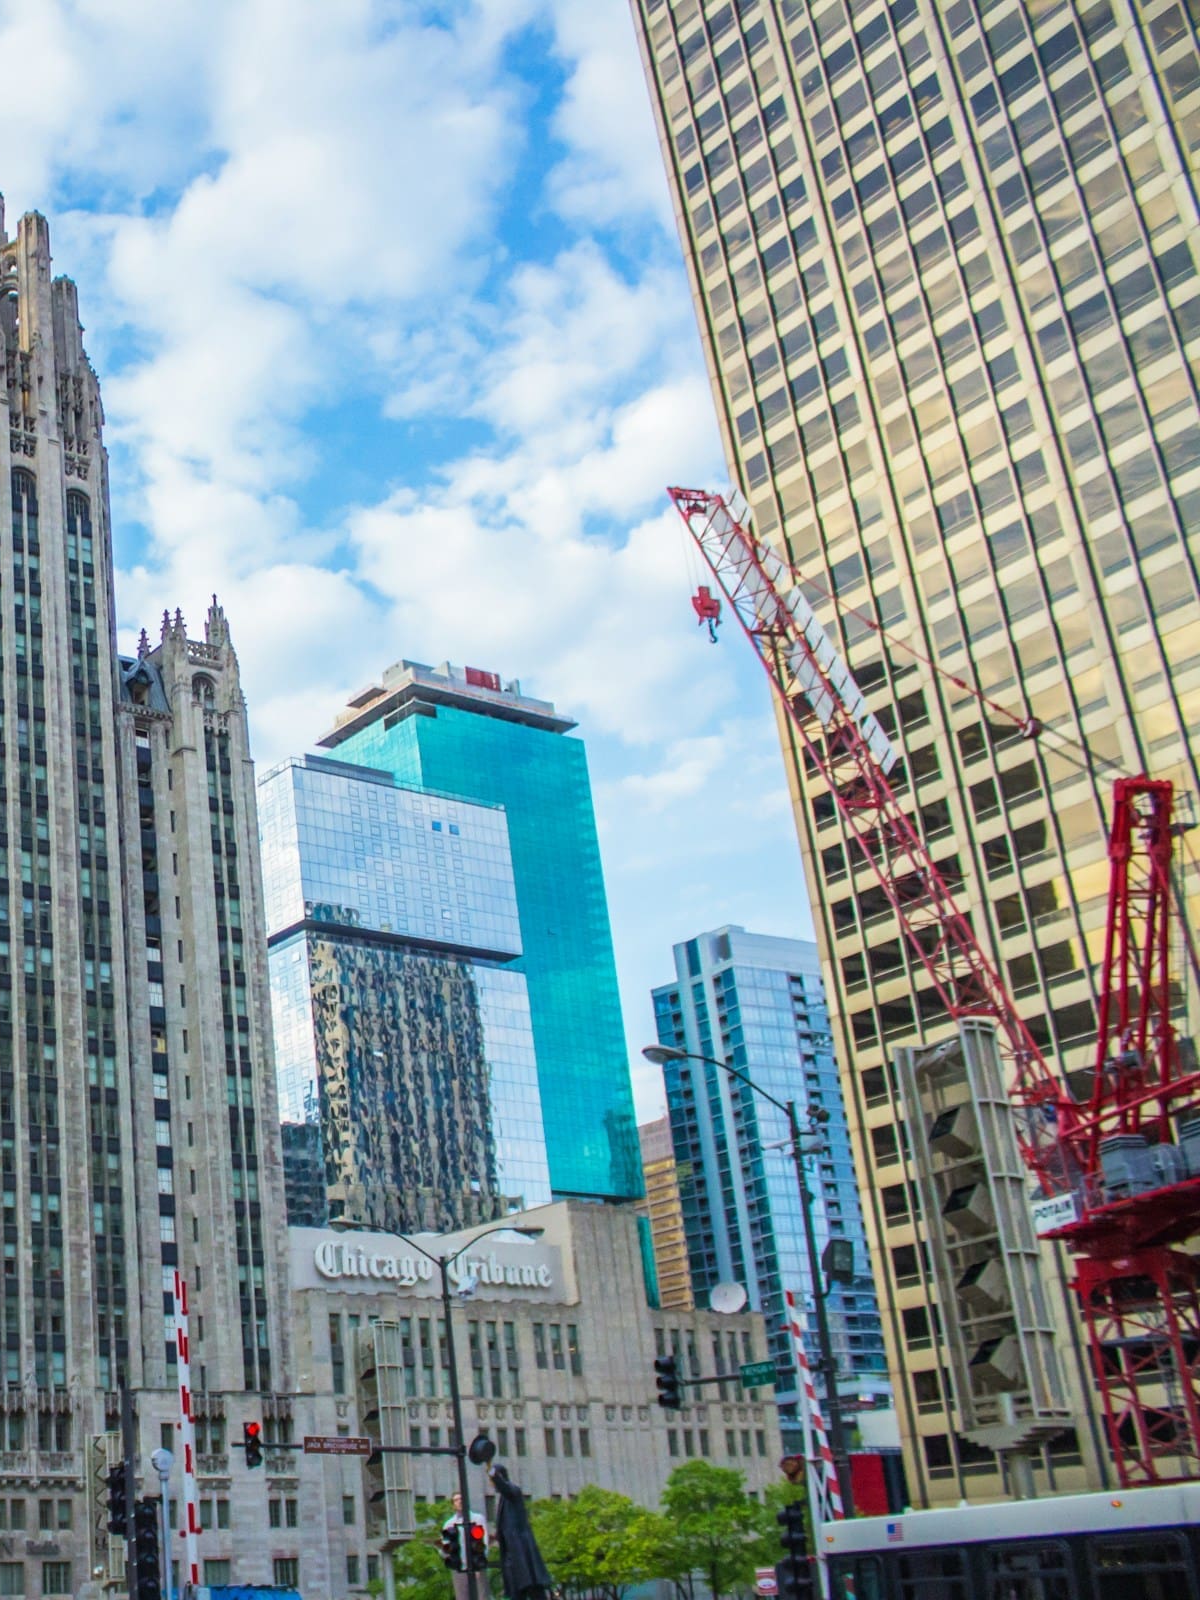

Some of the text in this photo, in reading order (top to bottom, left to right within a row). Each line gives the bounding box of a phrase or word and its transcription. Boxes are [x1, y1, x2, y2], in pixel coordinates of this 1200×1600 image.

[1033, 1199, 1073, 1218] POTAIN
[313, 1240, 554, 1289] Chicago Tribune
